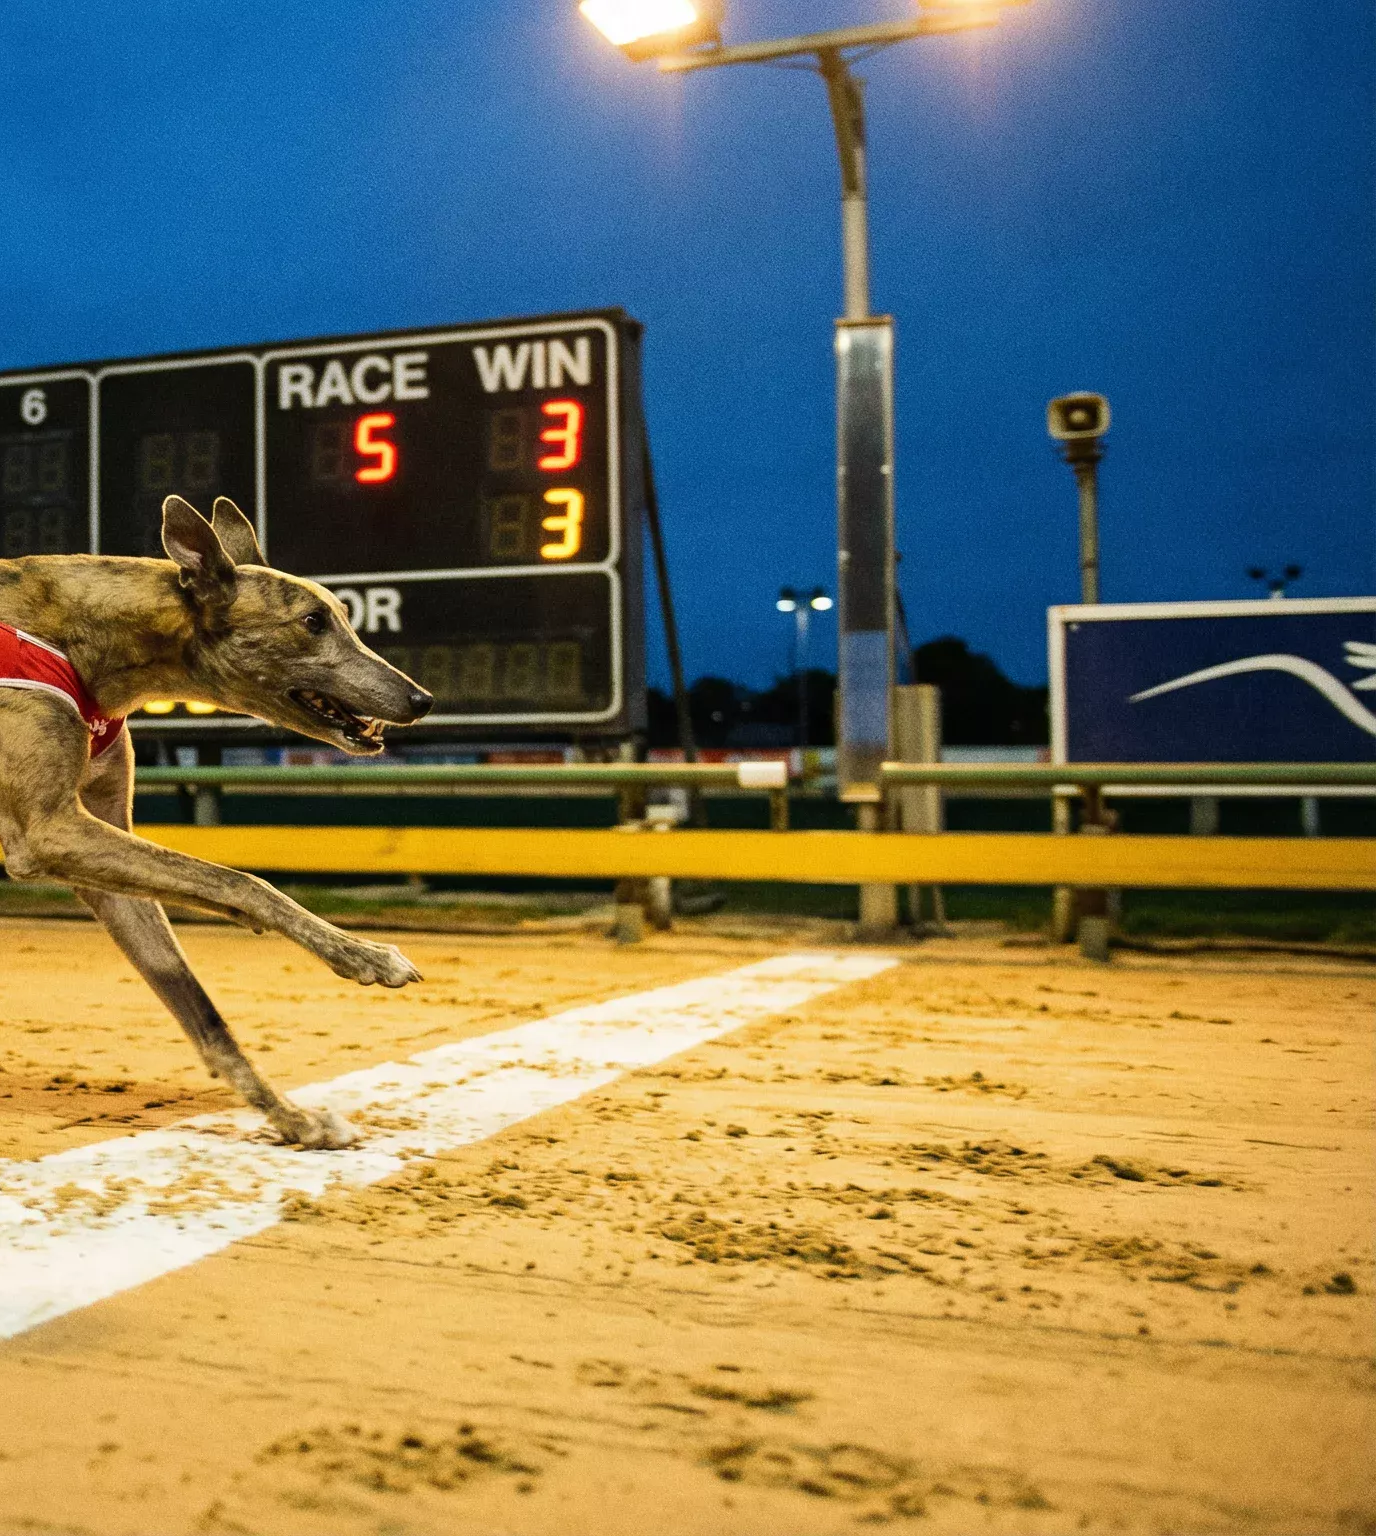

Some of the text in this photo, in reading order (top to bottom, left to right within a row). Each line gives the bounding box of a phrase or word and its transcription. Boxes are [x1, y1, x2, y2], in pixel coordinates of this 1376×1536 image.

[20, 389, 47, 425] 6
[277, 336, 591, 410] RACE WIN
[353, 398, 585, 484] 5 3
[538, 486, 586, 561] 3
